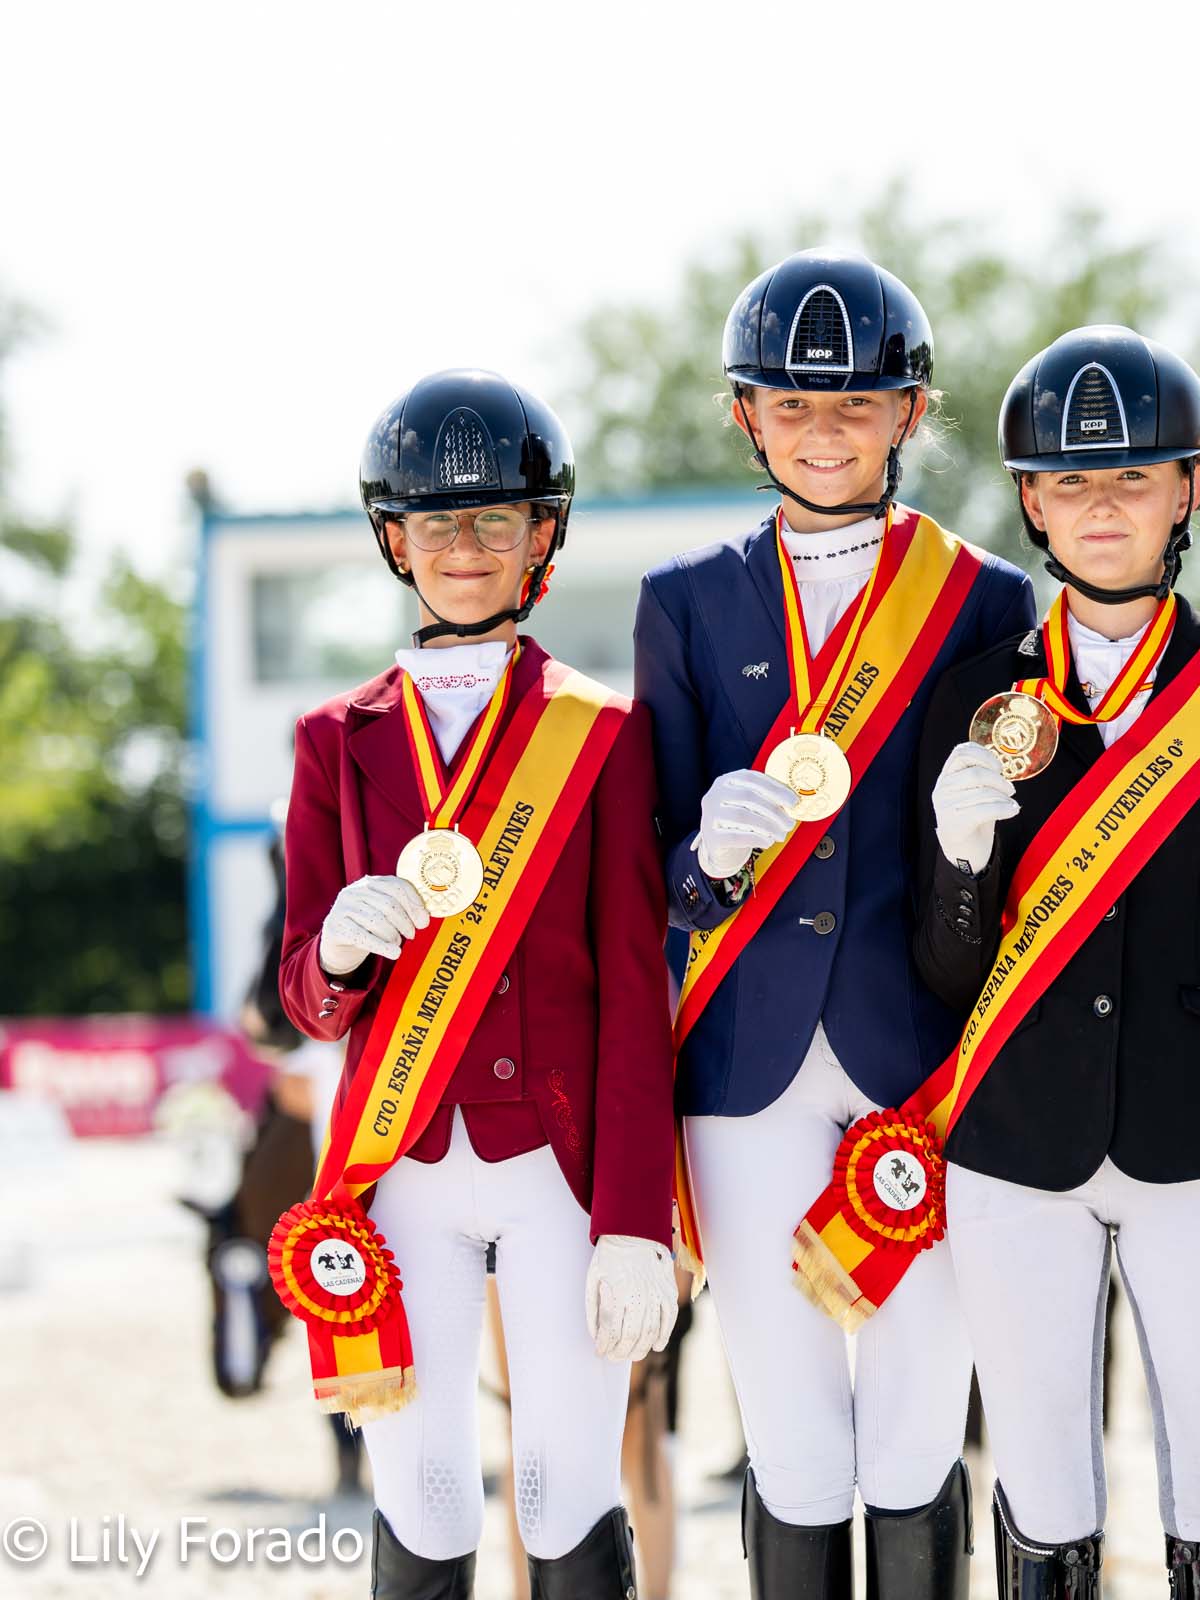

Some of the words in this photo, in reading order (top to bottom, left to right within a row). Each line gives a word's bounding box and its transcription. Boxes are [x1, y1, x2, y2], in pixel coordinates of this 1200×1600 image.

[373, 1098, 400, 1137] CTO.
[388, 1024, 429, 1095] ESPAÑA
[417, 932, 472, 1024] MENORES
[484, 801, 535, 891] ALEVINES
[960, 1021, 980, 1056] CTO.
[978, 954, 1017, 1019] ESPAÑA
[1013, 873, 1075, 957] MENORES
[1095, 754, 1173, 842] JUVENILES
